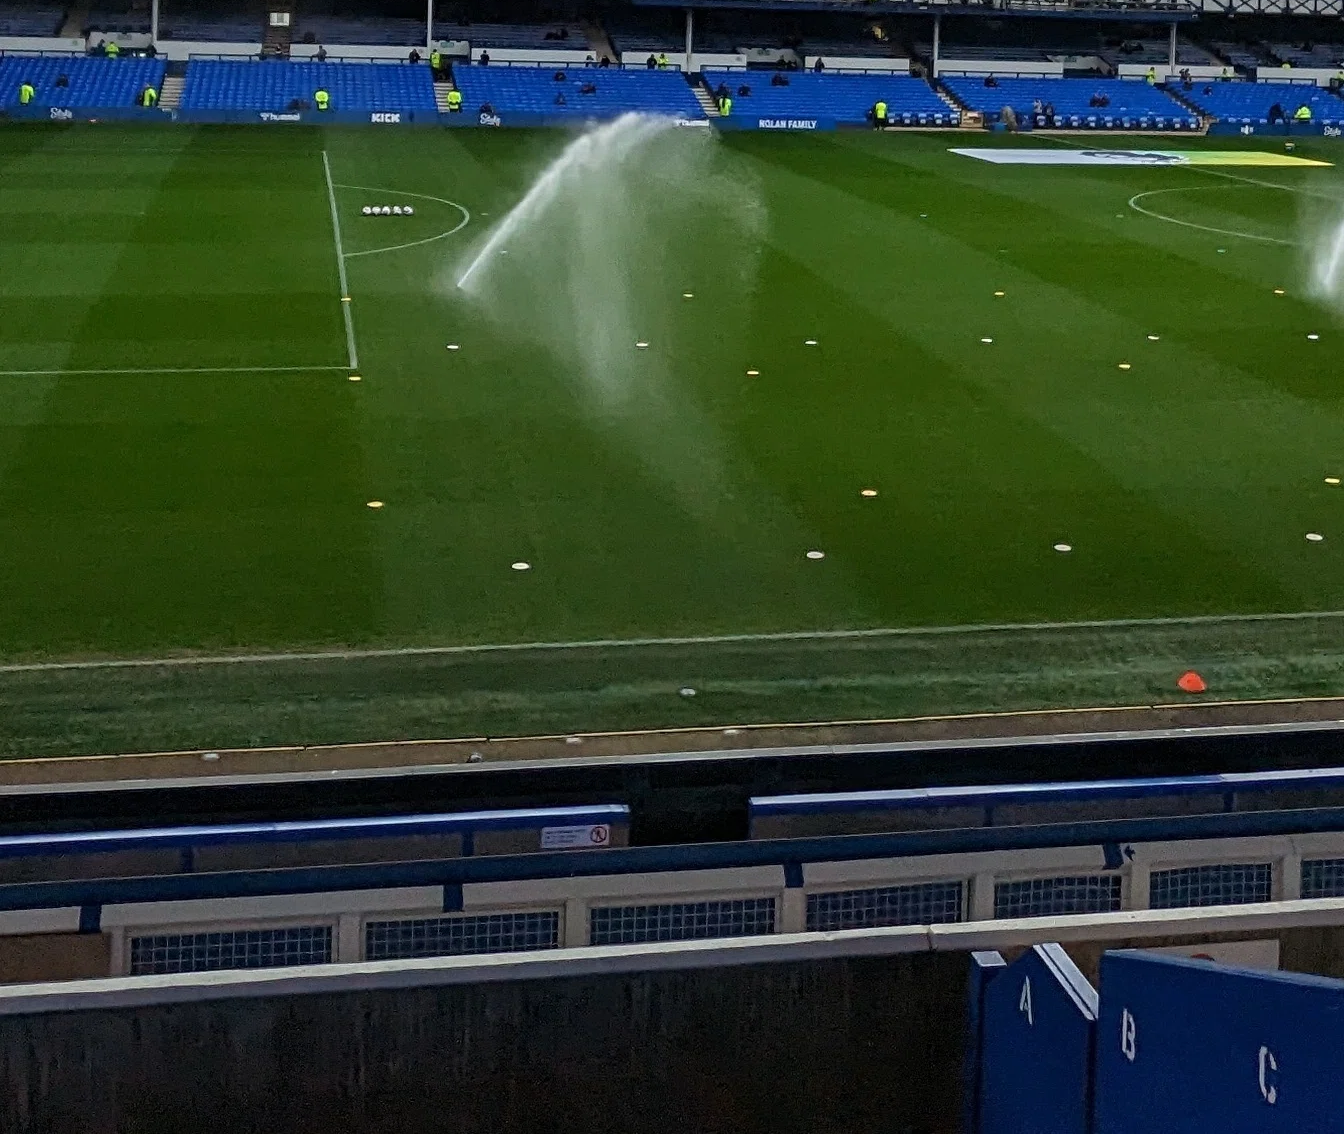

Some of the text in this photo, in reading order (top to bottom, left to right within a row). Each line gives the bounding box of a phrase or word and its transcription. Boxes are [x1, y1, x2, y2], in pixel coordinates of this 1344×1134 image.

[371, 113, 400, 123] KICK
[759, 119, 817, 129] NOLAN FAMILY
[1019, 975, 1034, 1026] A
[1121, 1007, 1136, 1063] B
[1259, 1045, 1278, 1104] C
